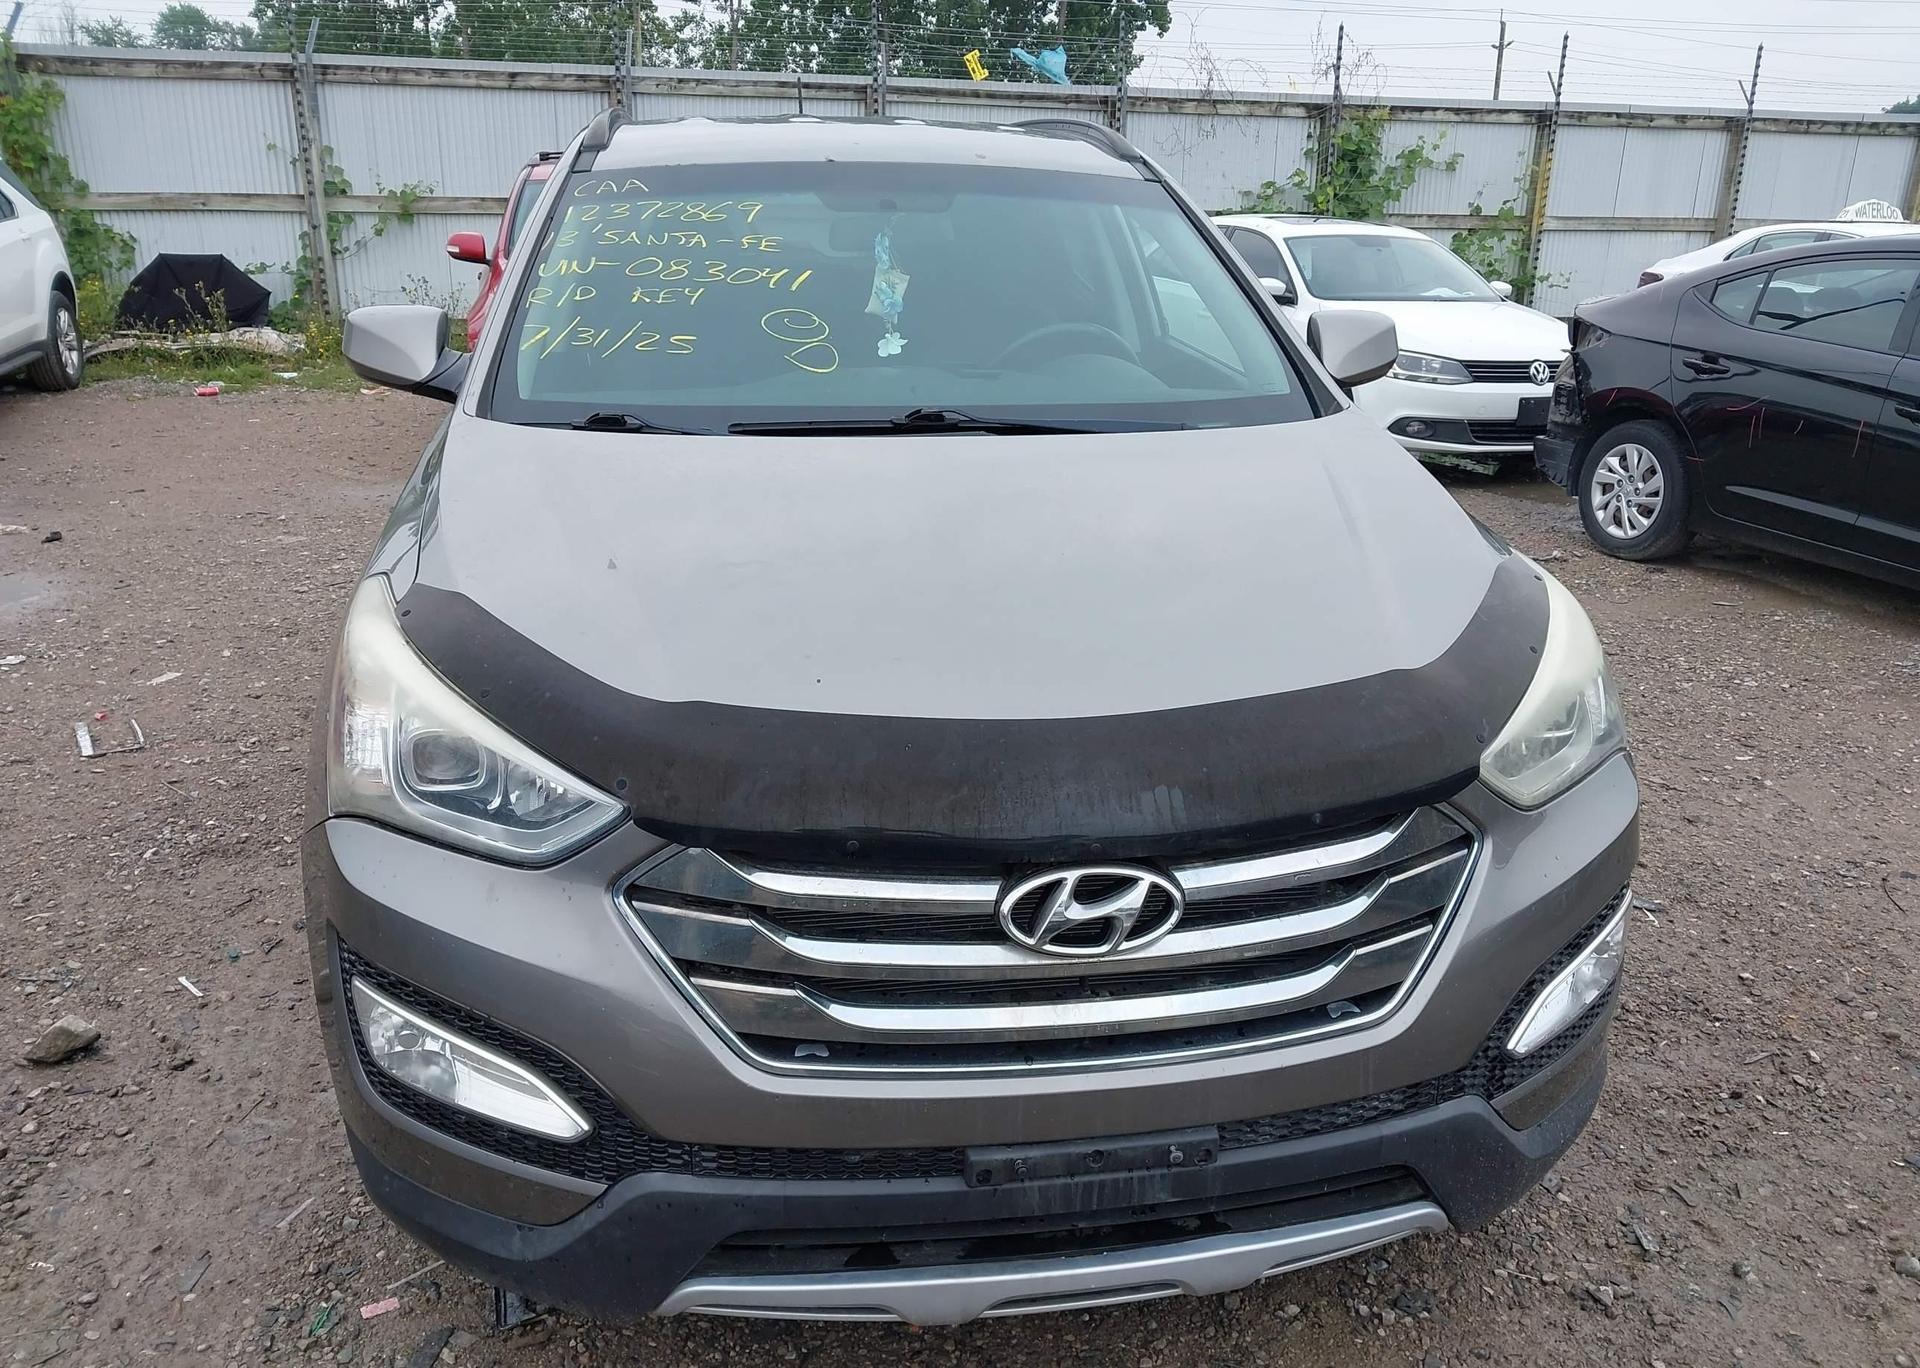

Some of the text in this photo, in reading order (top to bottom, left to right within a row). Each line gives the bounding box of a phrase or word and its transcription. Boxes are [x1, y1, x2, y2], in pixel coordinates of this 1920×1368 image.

[574, 179, 650, 197] CAA
[563, 200, 764, 224] 12372869
[1855, 201, 1899, 220] WATERLOO
[630, 286, 705, 306] KEY
[519, 315, 698, 360] 7/31/25
